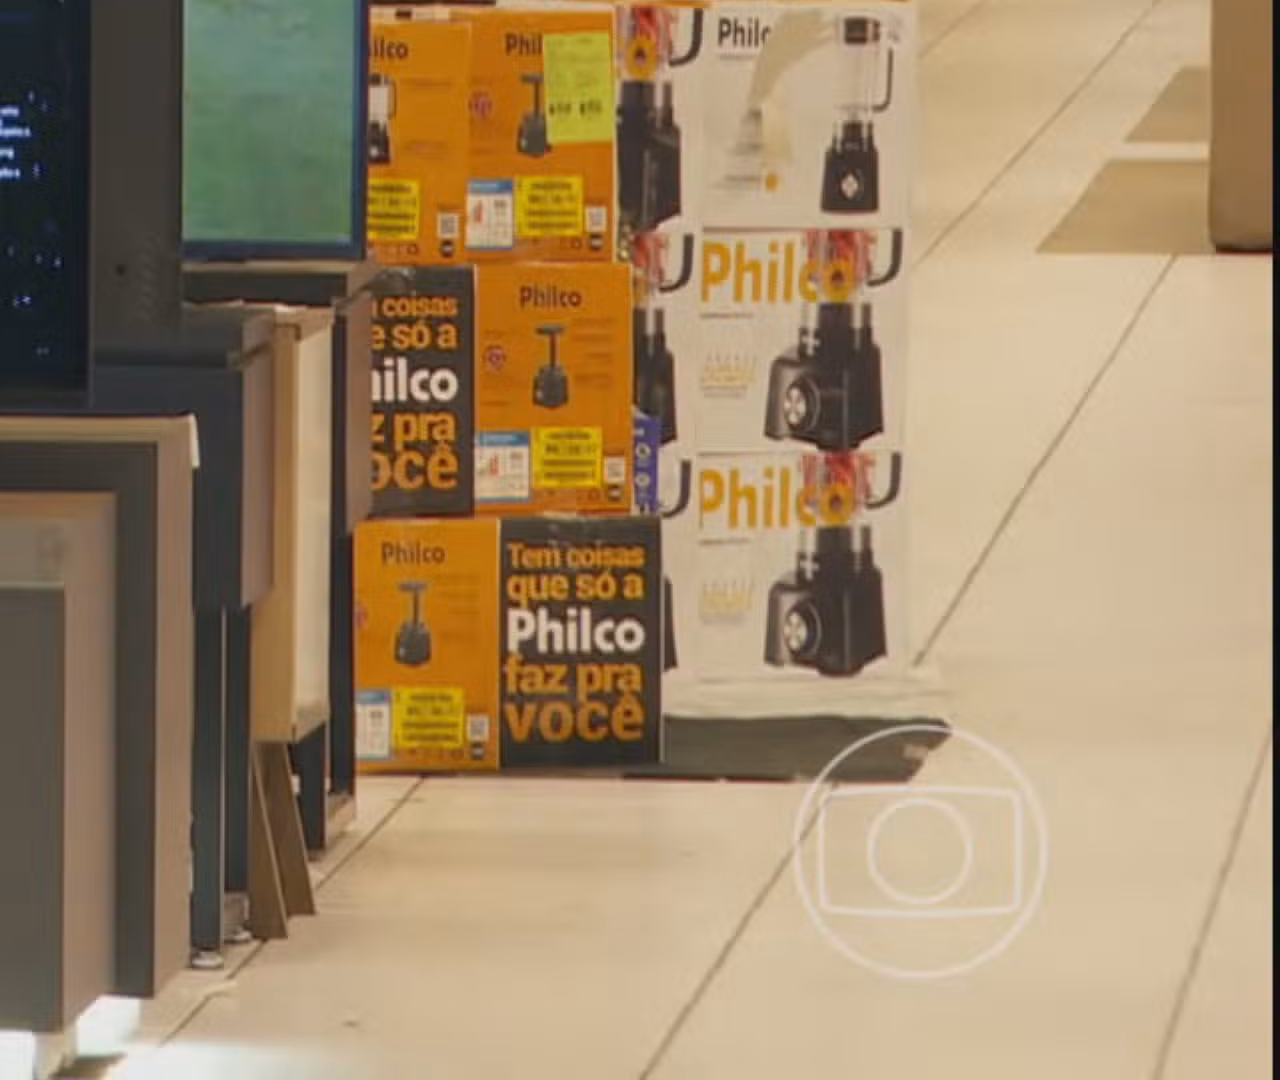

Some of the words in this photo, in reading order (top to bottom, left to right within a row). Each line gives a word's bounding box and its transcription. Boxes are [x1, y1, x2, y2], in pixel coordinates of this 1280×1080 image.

[369, 40, 408, 58] ilco
[701, 239, 858, 304] Philco
[384, 296, 458, 317] coisas
[520, 286, 583, 309] Philco
[393, 320, 432, 350] só
[438, 325, 458, 349] a
[394, 412, 456, 451] pra
[699, 467, 856, 529] Philco
[381, 542, 446, 566] Philco
[507, 543, 561, 568] Tem
[566, 540, 645, 568] coisas
[507, 574, 570, 609] que
[576, 568, 617, 601] só
[623, 575, 644, 600] a
[507, 608, 646, 653] Philco
[504, 651, 568, 695] faz
[576, 664, 642, 703] pra
[504, 691, 645, 743] você
